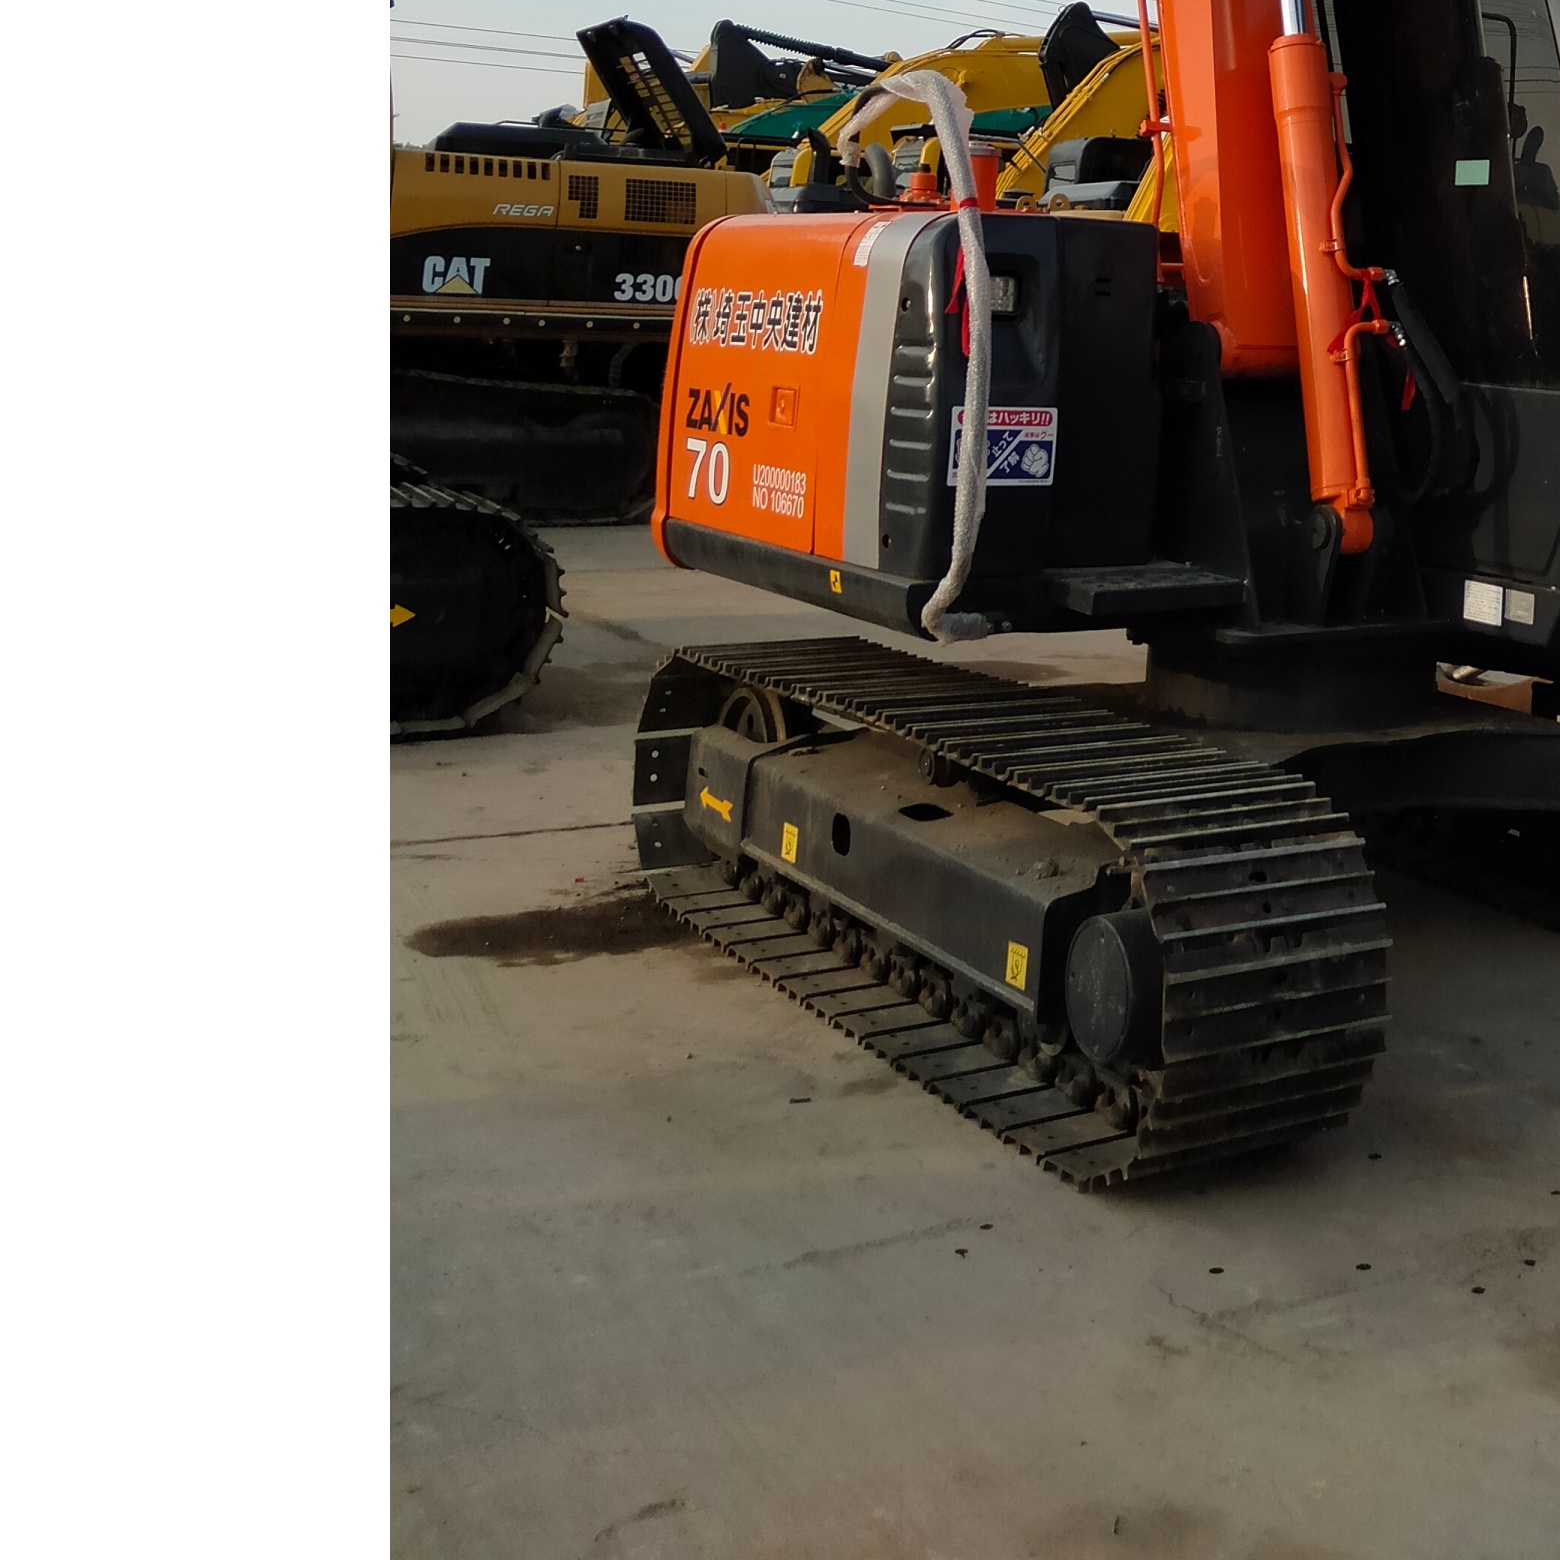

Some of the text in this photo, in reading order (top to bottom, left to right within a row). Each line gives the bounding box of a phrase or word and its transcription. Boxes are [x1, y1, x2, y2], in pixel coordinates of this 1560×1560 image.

[492, 203, 555, 217] REGA
[422, 255, 491, 295] CAT
[613, 273, 682, 302] 330
[686, 382, 751, 437] ZAXIS
[685, 437, 731, 506] 70
[752, 463, 807, 494] U200000183
[752, 486, 805, 519] NO 106670
